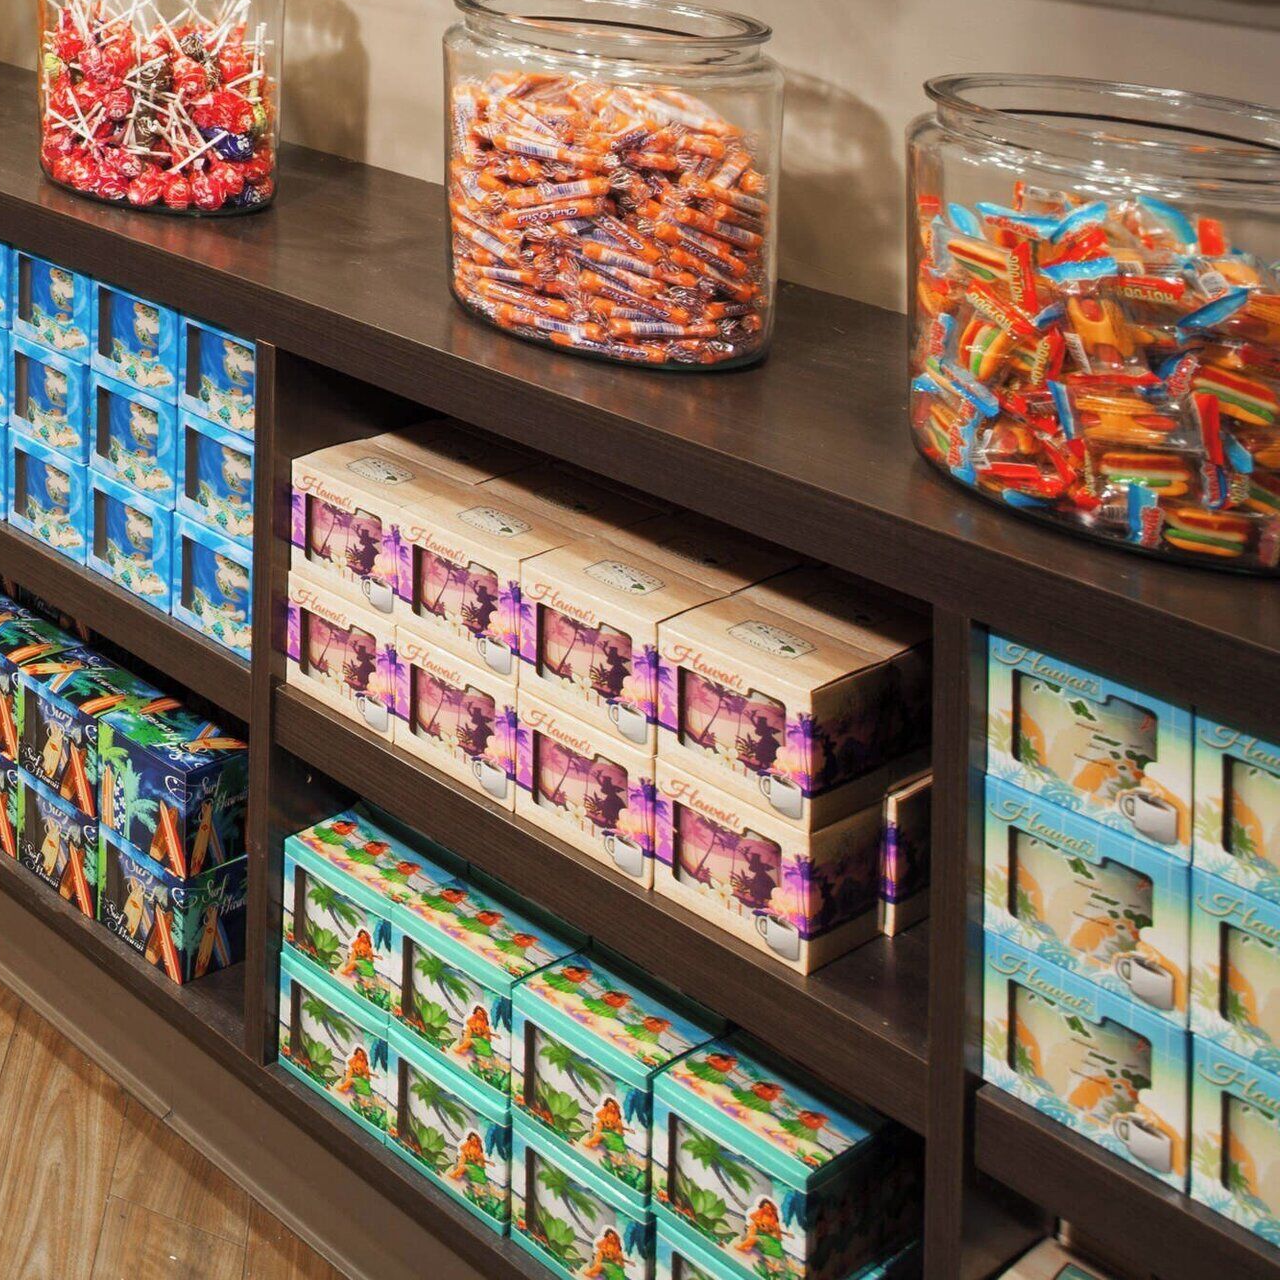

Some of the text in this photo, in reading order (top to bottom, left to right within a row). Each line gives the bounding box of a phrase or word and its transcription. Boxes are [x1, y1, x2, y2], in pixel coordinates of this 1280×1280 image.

[293, 474, 354, 511] Hawai'i
[402, 524, 467, 564] Hawai'i
[289, 587, 348, 625] Hawai'i
[525, 583, 597, 624] Hawai'i
[399, 642, 463, 686] Hawai'i
[663, 643, 745, 690] Hawai'i
[992, 642, 1101, 698] Hawai'i
[522, 707, 593, 755] Hawai'i
[660, 776, 743, 829] Hawai'i
[988, 798, 1096, 859] Hawai'i
[988, 954, 1096, 1017] Hawai'i
